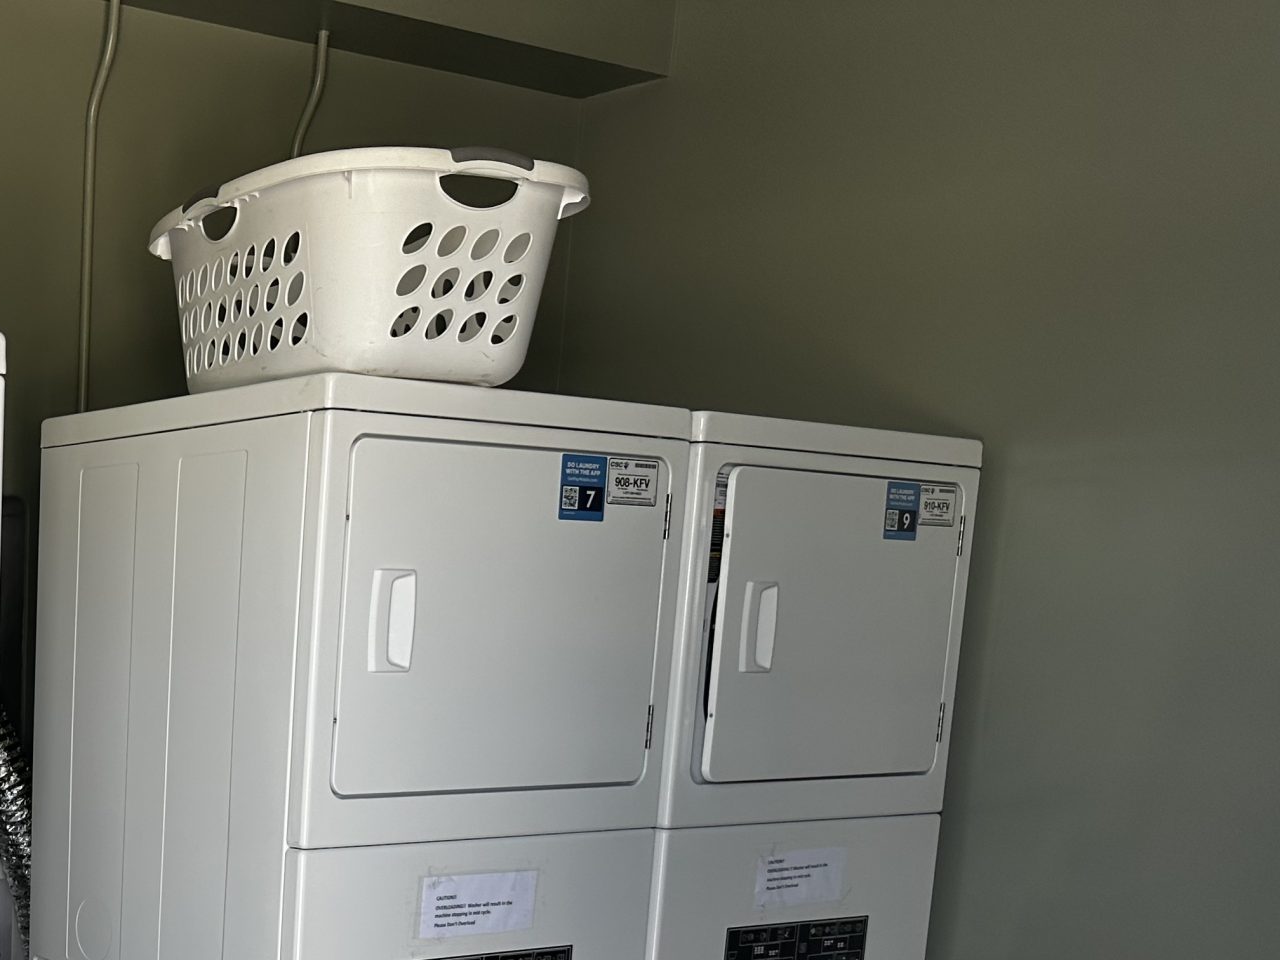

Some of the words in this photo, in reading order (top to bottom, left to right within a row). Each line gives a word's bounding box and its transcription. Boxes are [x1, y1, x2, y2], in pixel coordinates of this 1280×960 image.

[615, 477, 650, 488] 908-KFV
[586, 491, 595, 508] 7
[903, 513, 910, 529] 9
